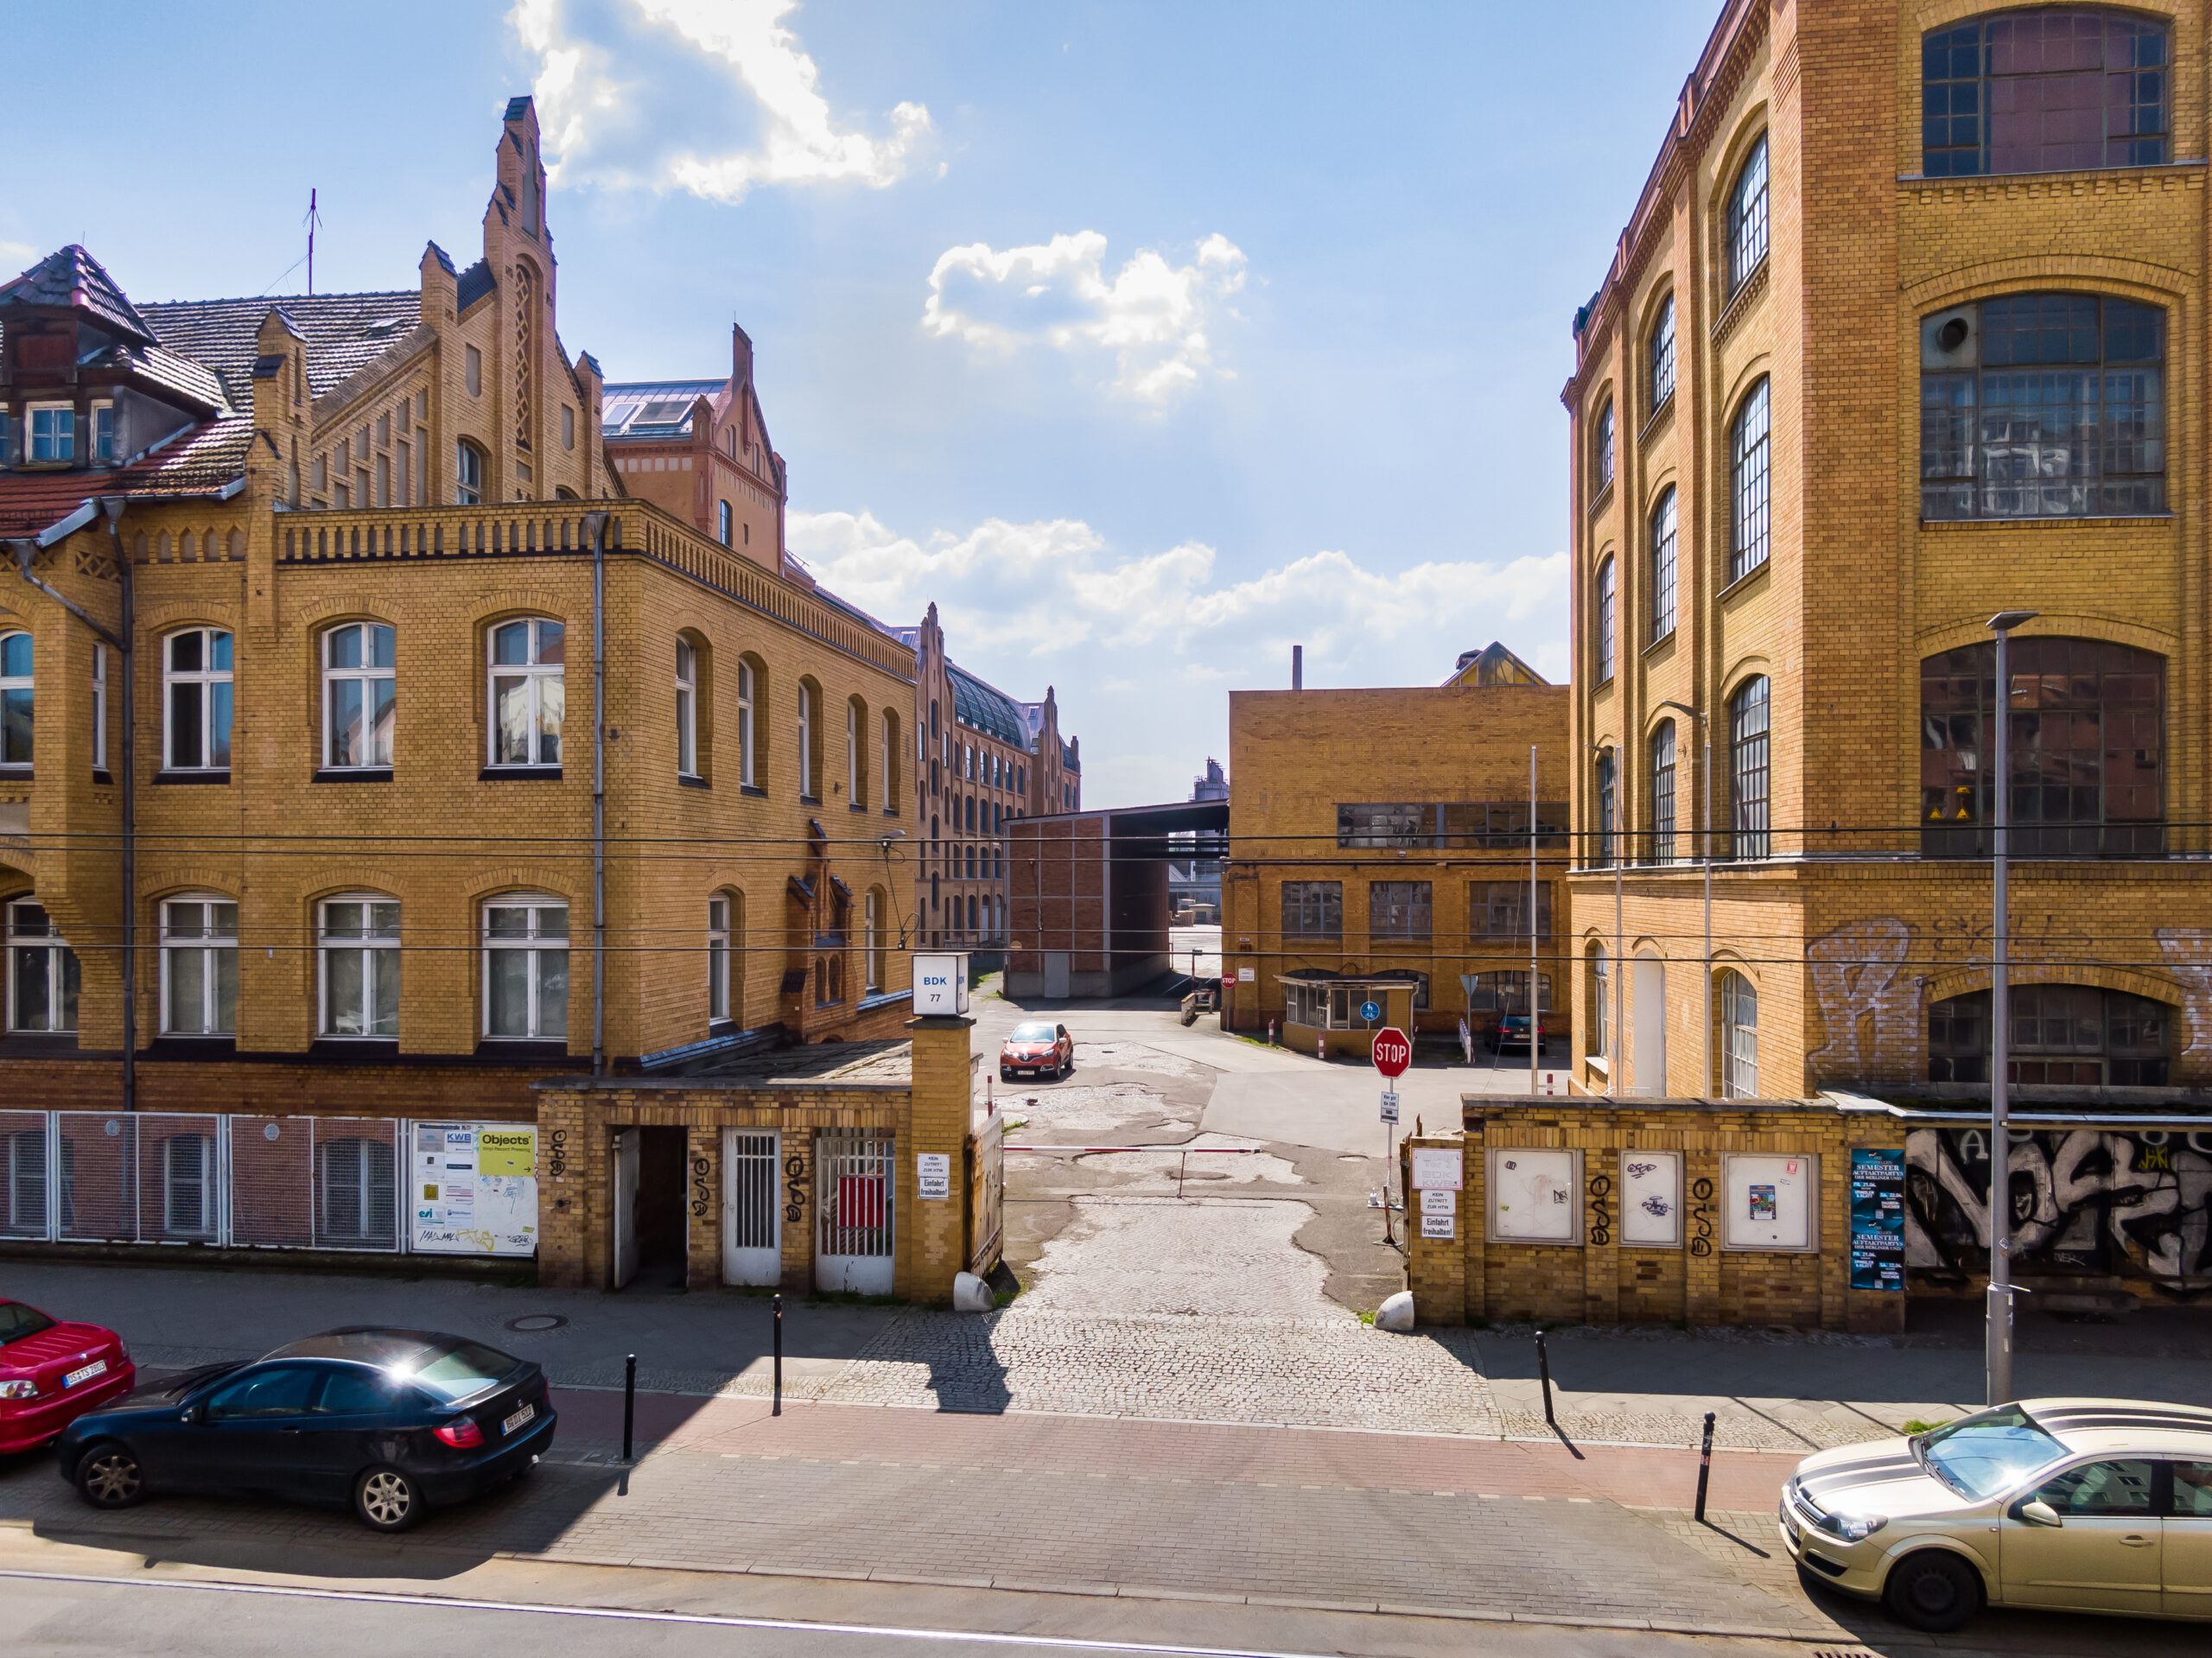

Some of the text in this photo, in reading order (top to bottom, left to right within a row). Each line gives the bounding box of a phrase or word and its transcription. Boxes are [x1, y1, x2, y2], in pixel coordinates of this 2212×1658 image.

[924, 976, 947, 985] BDK
[930, 994, 941, 1002] 77
[1376, 1043, 1407, 1064] STOP
[448, 1133, 472, 1141] KWB
[482, 1134, 530, 1147] Objects
[418, 1208, 433, 1218] esi
[1423, 1227, 1452, 1236] freihalten!
